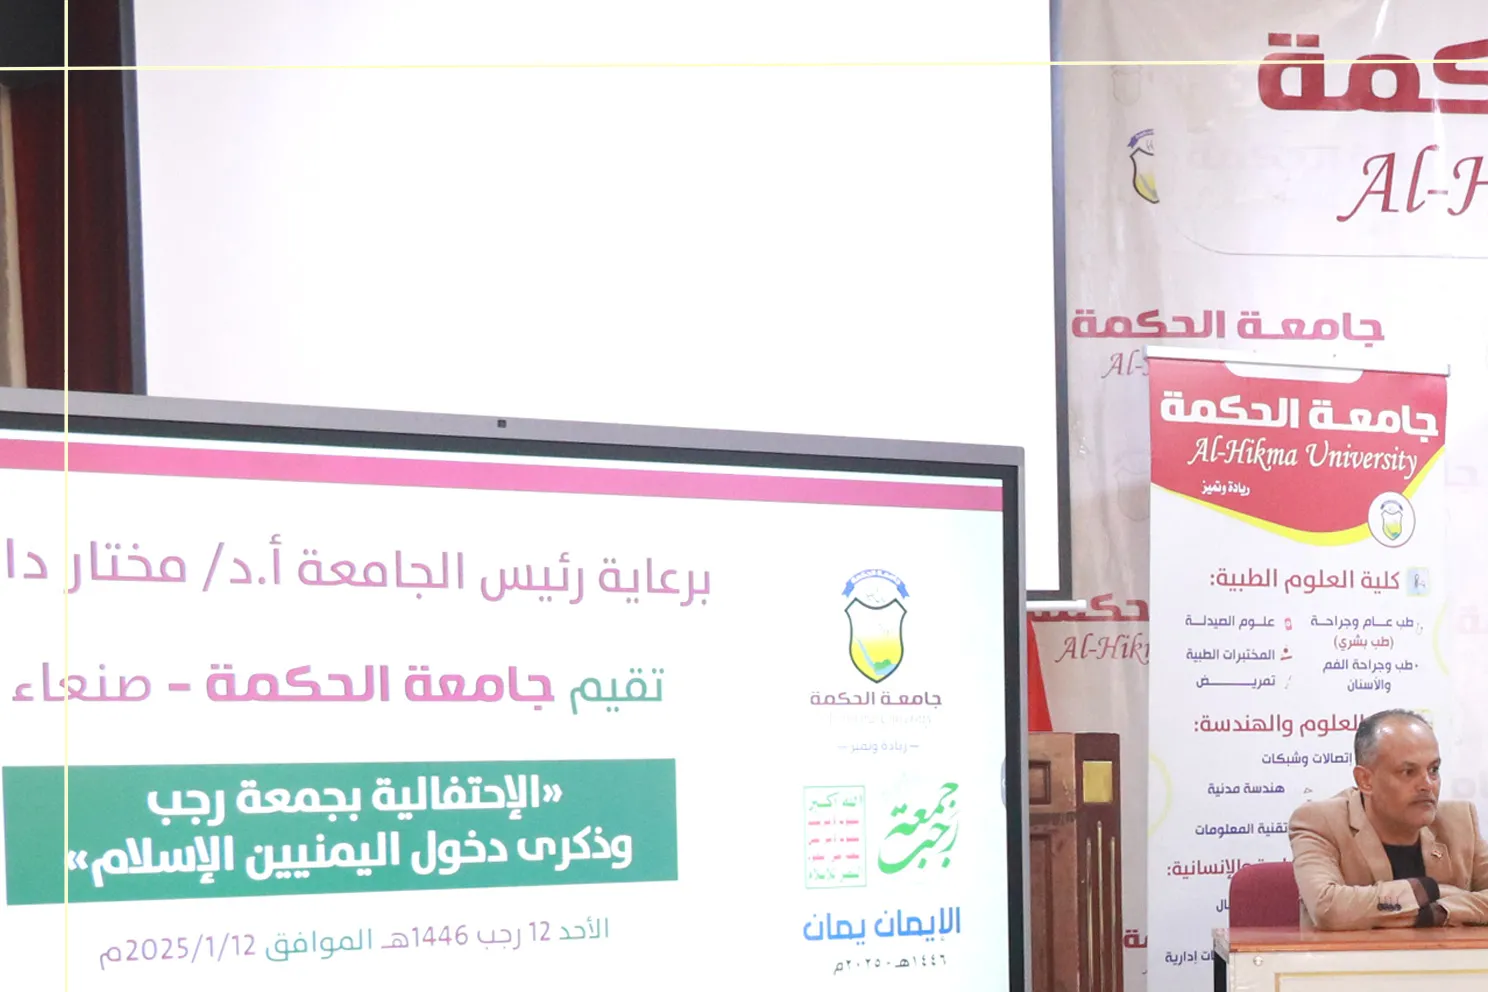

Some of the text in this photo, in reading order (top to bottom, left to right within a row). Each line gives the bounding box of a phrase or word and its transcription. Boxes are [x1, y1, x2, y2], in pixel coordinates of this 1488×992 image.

[1071, 309, 1385, 348] جامعة الحكمة
[1160, 391, 1439, 443] جامعة الحكمة
[1187, 437, 1418, 480] Al-Hikma University
[1201, 479, 1250, 496] ريادة وتميز
[66, 539, 187, 595] مختار
[298, 548, 465, 600] الجامعة
[480, 552, 585, 602] رئيس
[598, 552, 711, 607] برعاية
[1210, 568, 1400, 594] كلية العلوم الطبية:
[1185, 615, 1275, 629] علوم الصيدلة
[1311, 615, 1359, 629] وجراحة
[1396, 616, 1414, 628] طب
[1055, 632, 1149, 665] Al-Hik
[1186, 649, 1275, 664] المختبرات الطبية
[1334, 636, 1394, 651] (طب بشري)
[12, 661, 153, 702] صنعاء
[205, 663, 390, 702] الحكمة
[1196, 675, 1276, 689] تمريض
[1322, 659, 1348, 673] الفم
[1352, 659, 1392, 673] وجراحة
[403, 664, 556, 712] جامعة
[569, 667, 666, 715] تقيم
[810, 691, 942, 709] جامعة الحكمة
[1194, 714, 1293, 738] والهندسة:
[1262, 753, 1308, 768] وشبكات
[236, 779, 362, 823] بجمعة
[1207, 782, 1285, 796] هندسة مدنية
[146, 784, 226, 828] رجب
[1195, 823, 1254, 839] المعلومات
[245, 831, 401, 881] اليمنيين
[410, 830, 508, 877] دخول
[517, 825, 634, 872] وذكرى
[476, 923, 523, 953] رجب
[528, 920, 551, 943] 12
[558, 916, 611, 943] الأحد
[803, 912, 866, 946] يمان
[264, 928, 373, 964] الموافق
